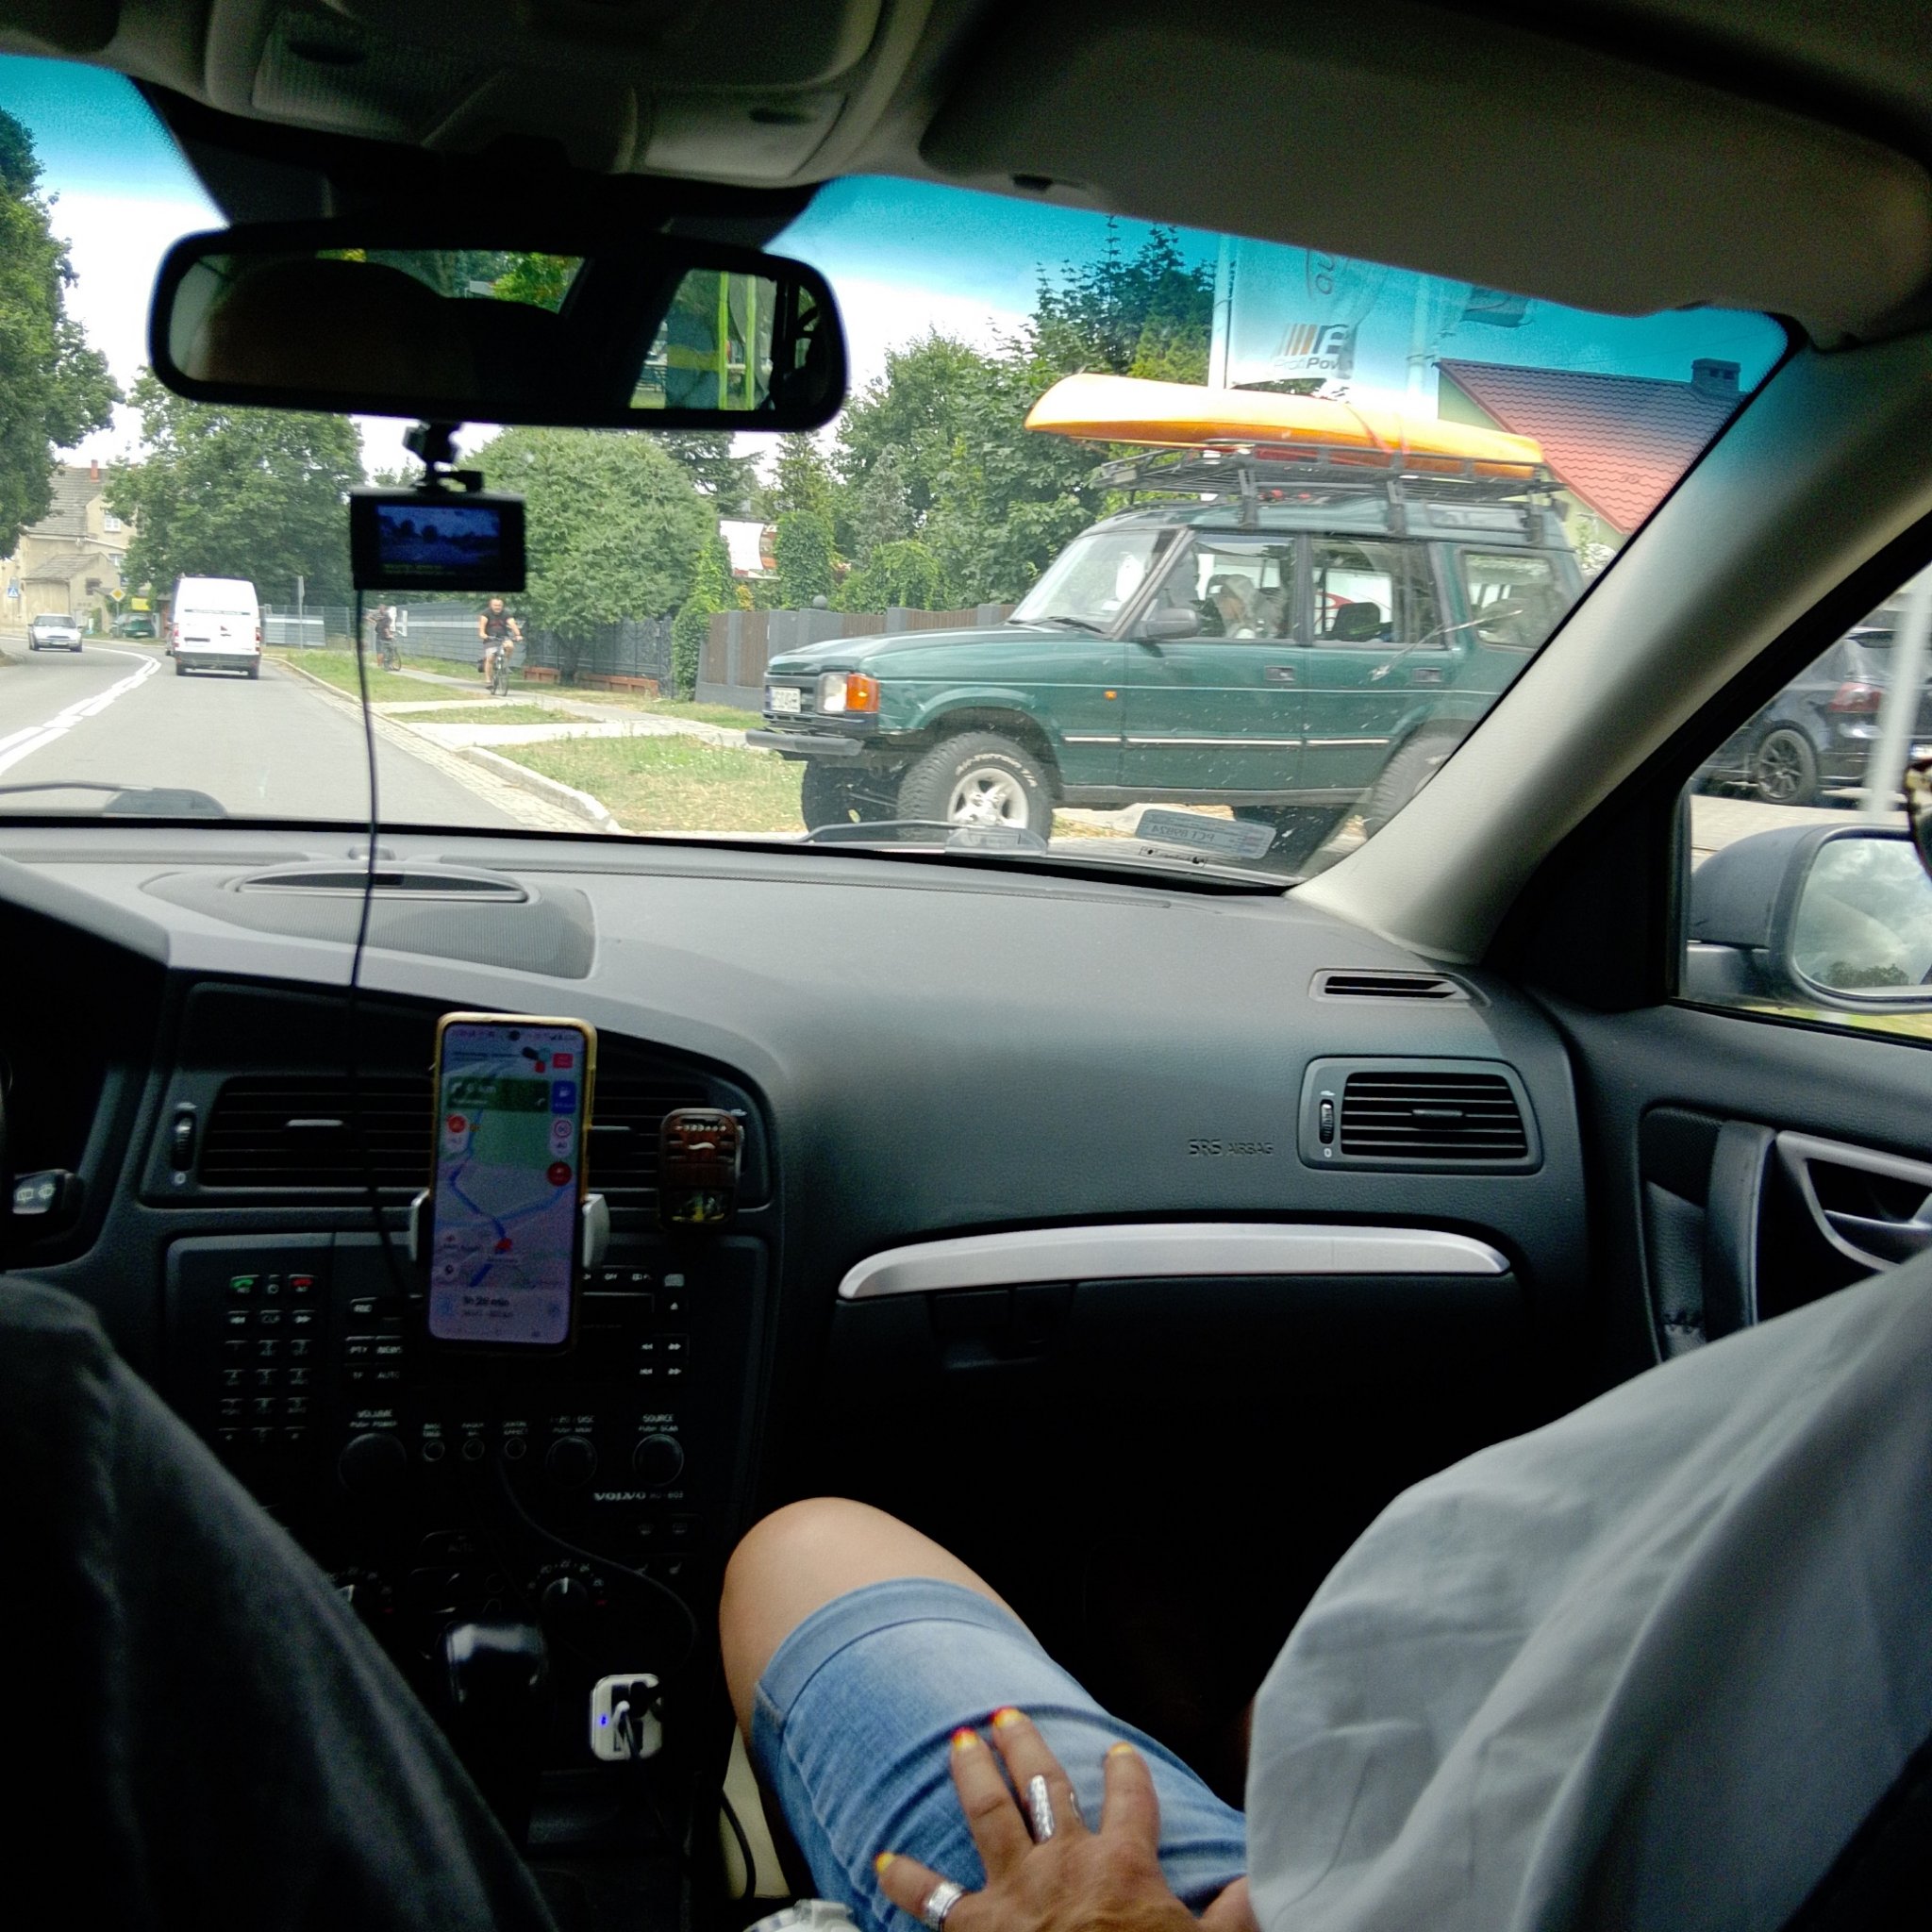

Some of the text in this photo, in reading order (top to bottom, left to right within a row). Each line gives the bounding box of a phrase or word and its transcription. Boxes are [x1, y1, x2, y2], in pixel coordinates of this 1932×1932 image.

[1188, 1139, 1274, 1156] SRS AIRBAG
[593, 1491, 646, 1502] VOLVO
